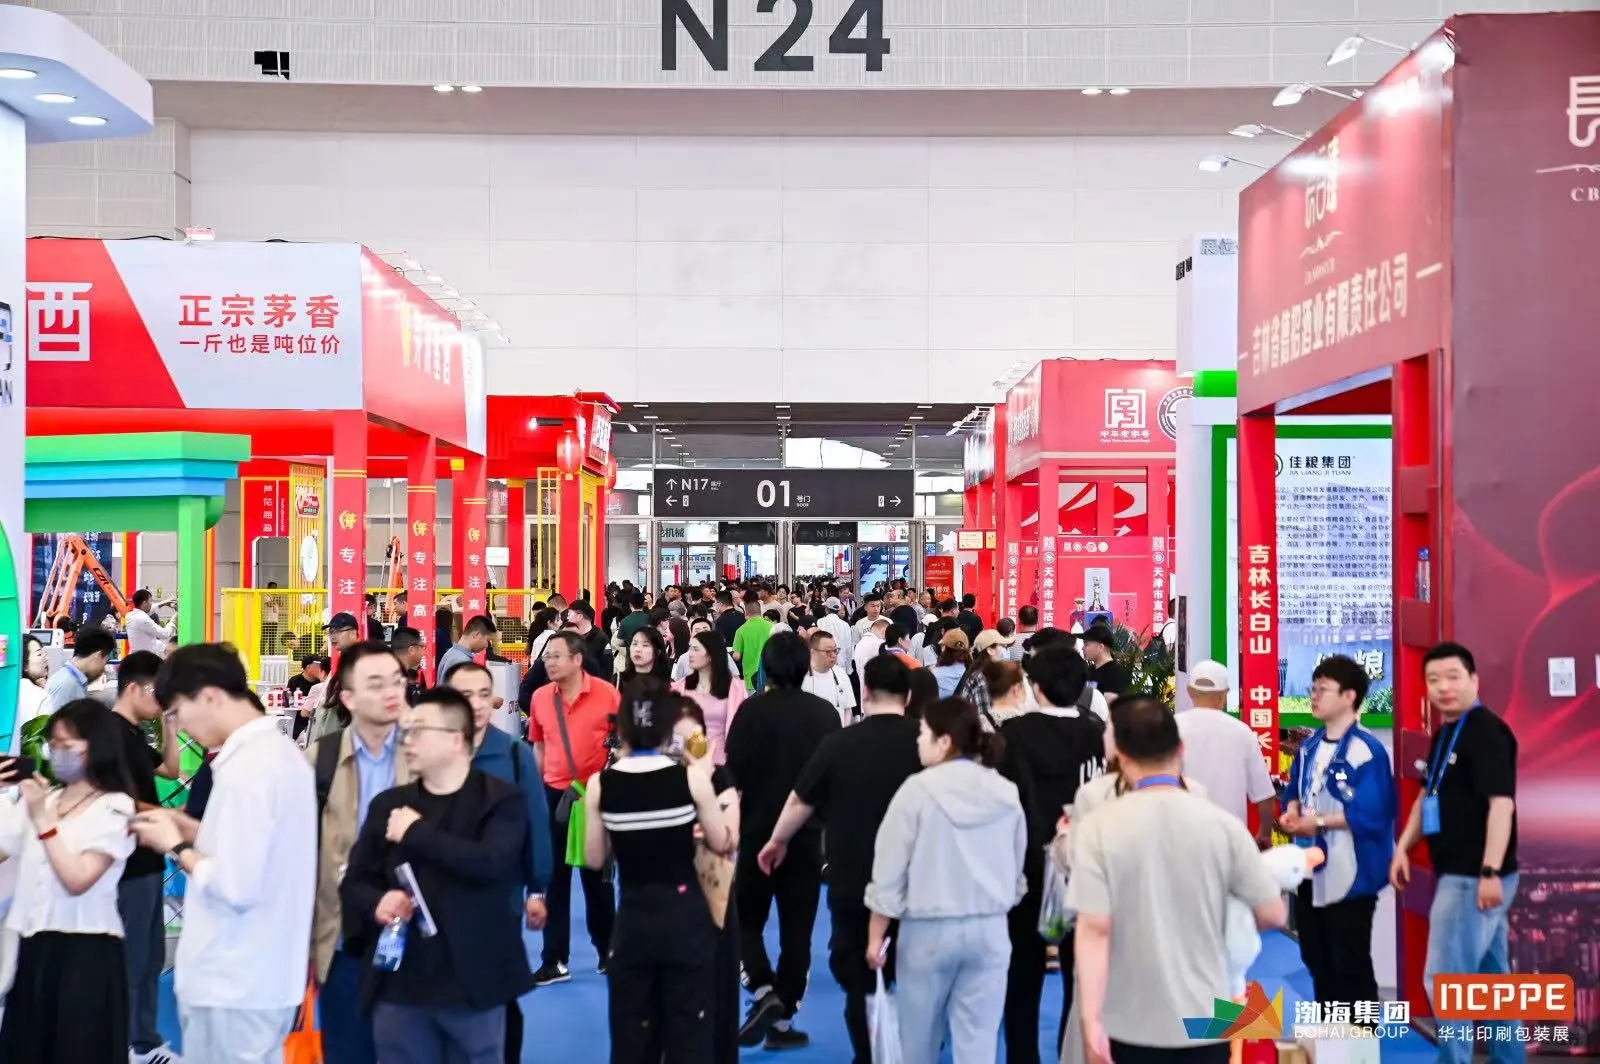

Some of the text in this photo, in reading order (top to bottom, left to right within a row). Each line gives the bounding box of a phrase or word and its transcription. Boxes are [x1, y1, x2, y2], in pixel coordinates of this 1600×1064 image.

[661, 0, 891, 72] N24
[178, 293, 340, 329] 正宗茅香
[179, 333, 341, 355] 一斤也是吨位价
[1289, 455, 1351, 469] 佳粮集团
[681, 478, 709, 491] N17
[756, 479, 791, 508] 01
[1248, 545, 1272, 655] 吉林长白山
